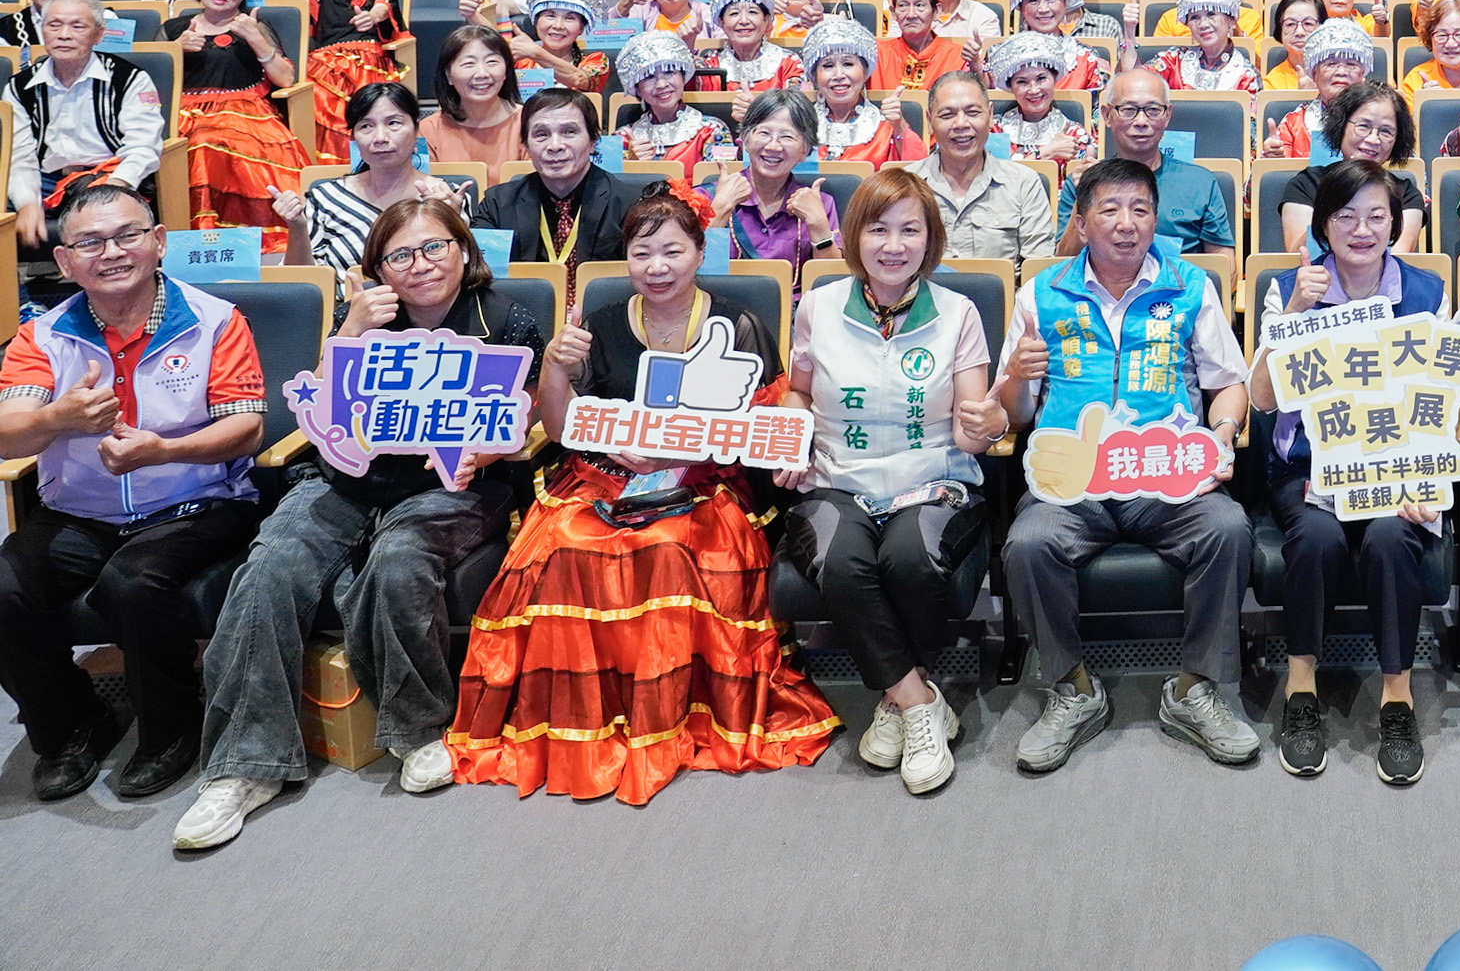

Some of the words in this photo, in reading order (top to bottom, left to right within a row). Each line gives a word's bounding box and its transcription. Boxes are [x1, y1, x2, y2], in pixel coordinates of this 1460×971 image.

[188, 248, 235, 265] 貴賓席
[1268, 302, 1386, 341] 新北市115年度
[363, 342, 473, 390] 活力
[1055, 318, 1082, 379] 彭順發
[1142, 319, 1172, 394] 陳鴻源
[371, 399, 517, 442] 動起來
[570, 404, 805, 464] 新北金甲讚
[1316, 392, 1446, 444] 成果展
[1107, 442, 1206, 480] 我最棒
[1322, 452, 1458, 487] 壯出下半場的
[1348, 481, 1439, 511] 輕銀人生
